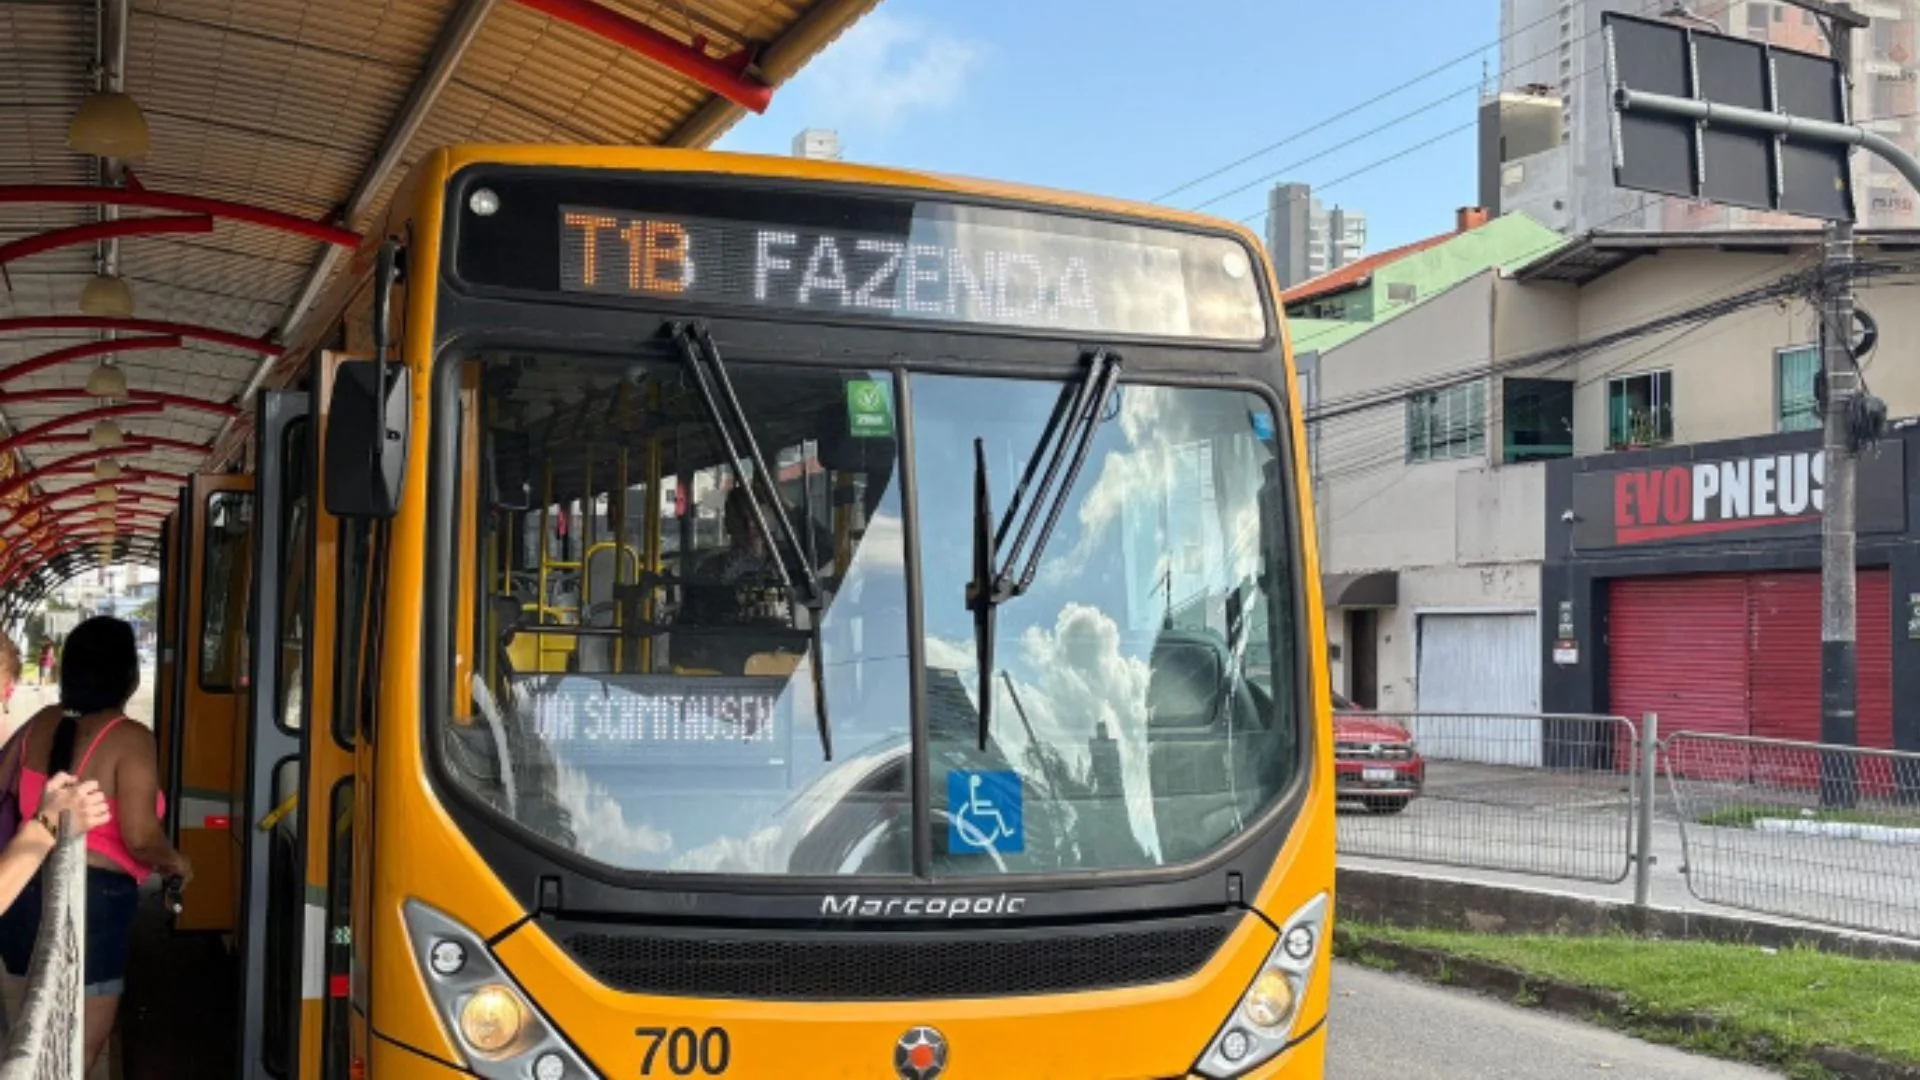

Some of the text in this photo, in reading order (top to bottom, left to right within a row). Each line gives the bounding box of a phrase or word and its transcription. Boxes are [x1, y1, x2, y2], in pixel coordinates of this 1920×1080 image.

[564, 213, 1099, 327] T1B FAZENDA
[820, 892, 1026, 919] Marcopolo
[634, 1026, 731, 1076] 700
